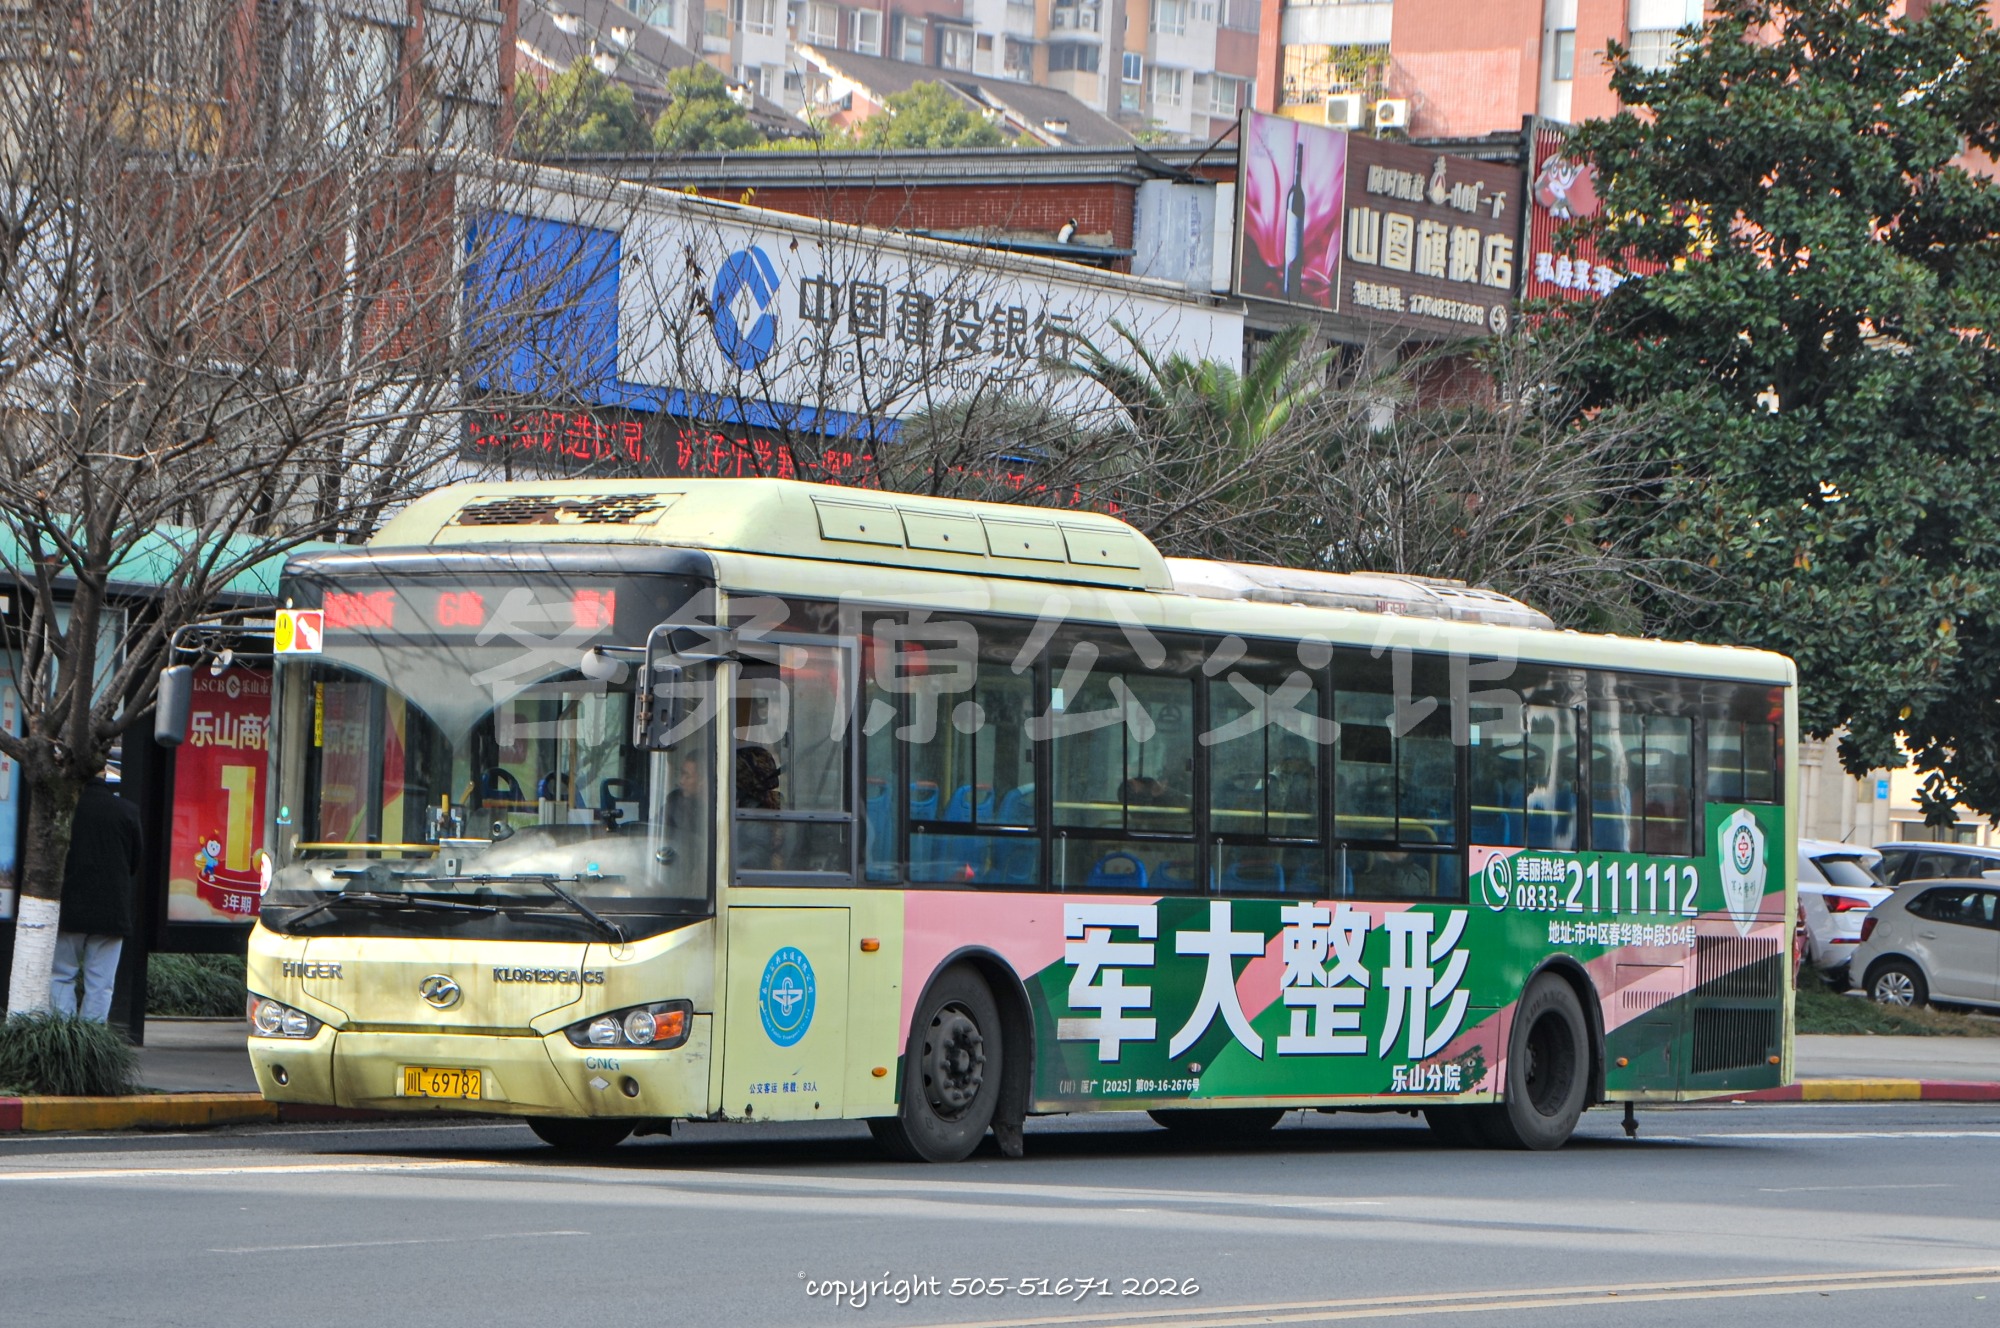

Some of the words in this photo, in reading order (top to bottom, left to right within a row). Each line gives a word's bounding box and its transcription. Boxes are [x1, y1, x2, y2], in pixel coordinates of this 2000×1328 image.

[1347, 206, 1514, 290] 山图旗舰店
[799, 274, 1073, 363] 中国建设银行
[798, 336, 855, 374] Chna
[863, 347, 983, 391] Constuction
[990, 366, 1037, 399] Bnk
[1376, 600, 1407, 615] HIGER
[193, 678, 225, 691] LSCB
[1516, 856, 1566, 883] 美丽热线
[222, 893, 252, 914] 3年期
[282, 961, 343, 979] HIGER
[1057, 900, 1471, 1062] 军大整形
[586, 1056, 620, 1072] CNG
[1390, 1063, 1462, 1093] 乐山分院
